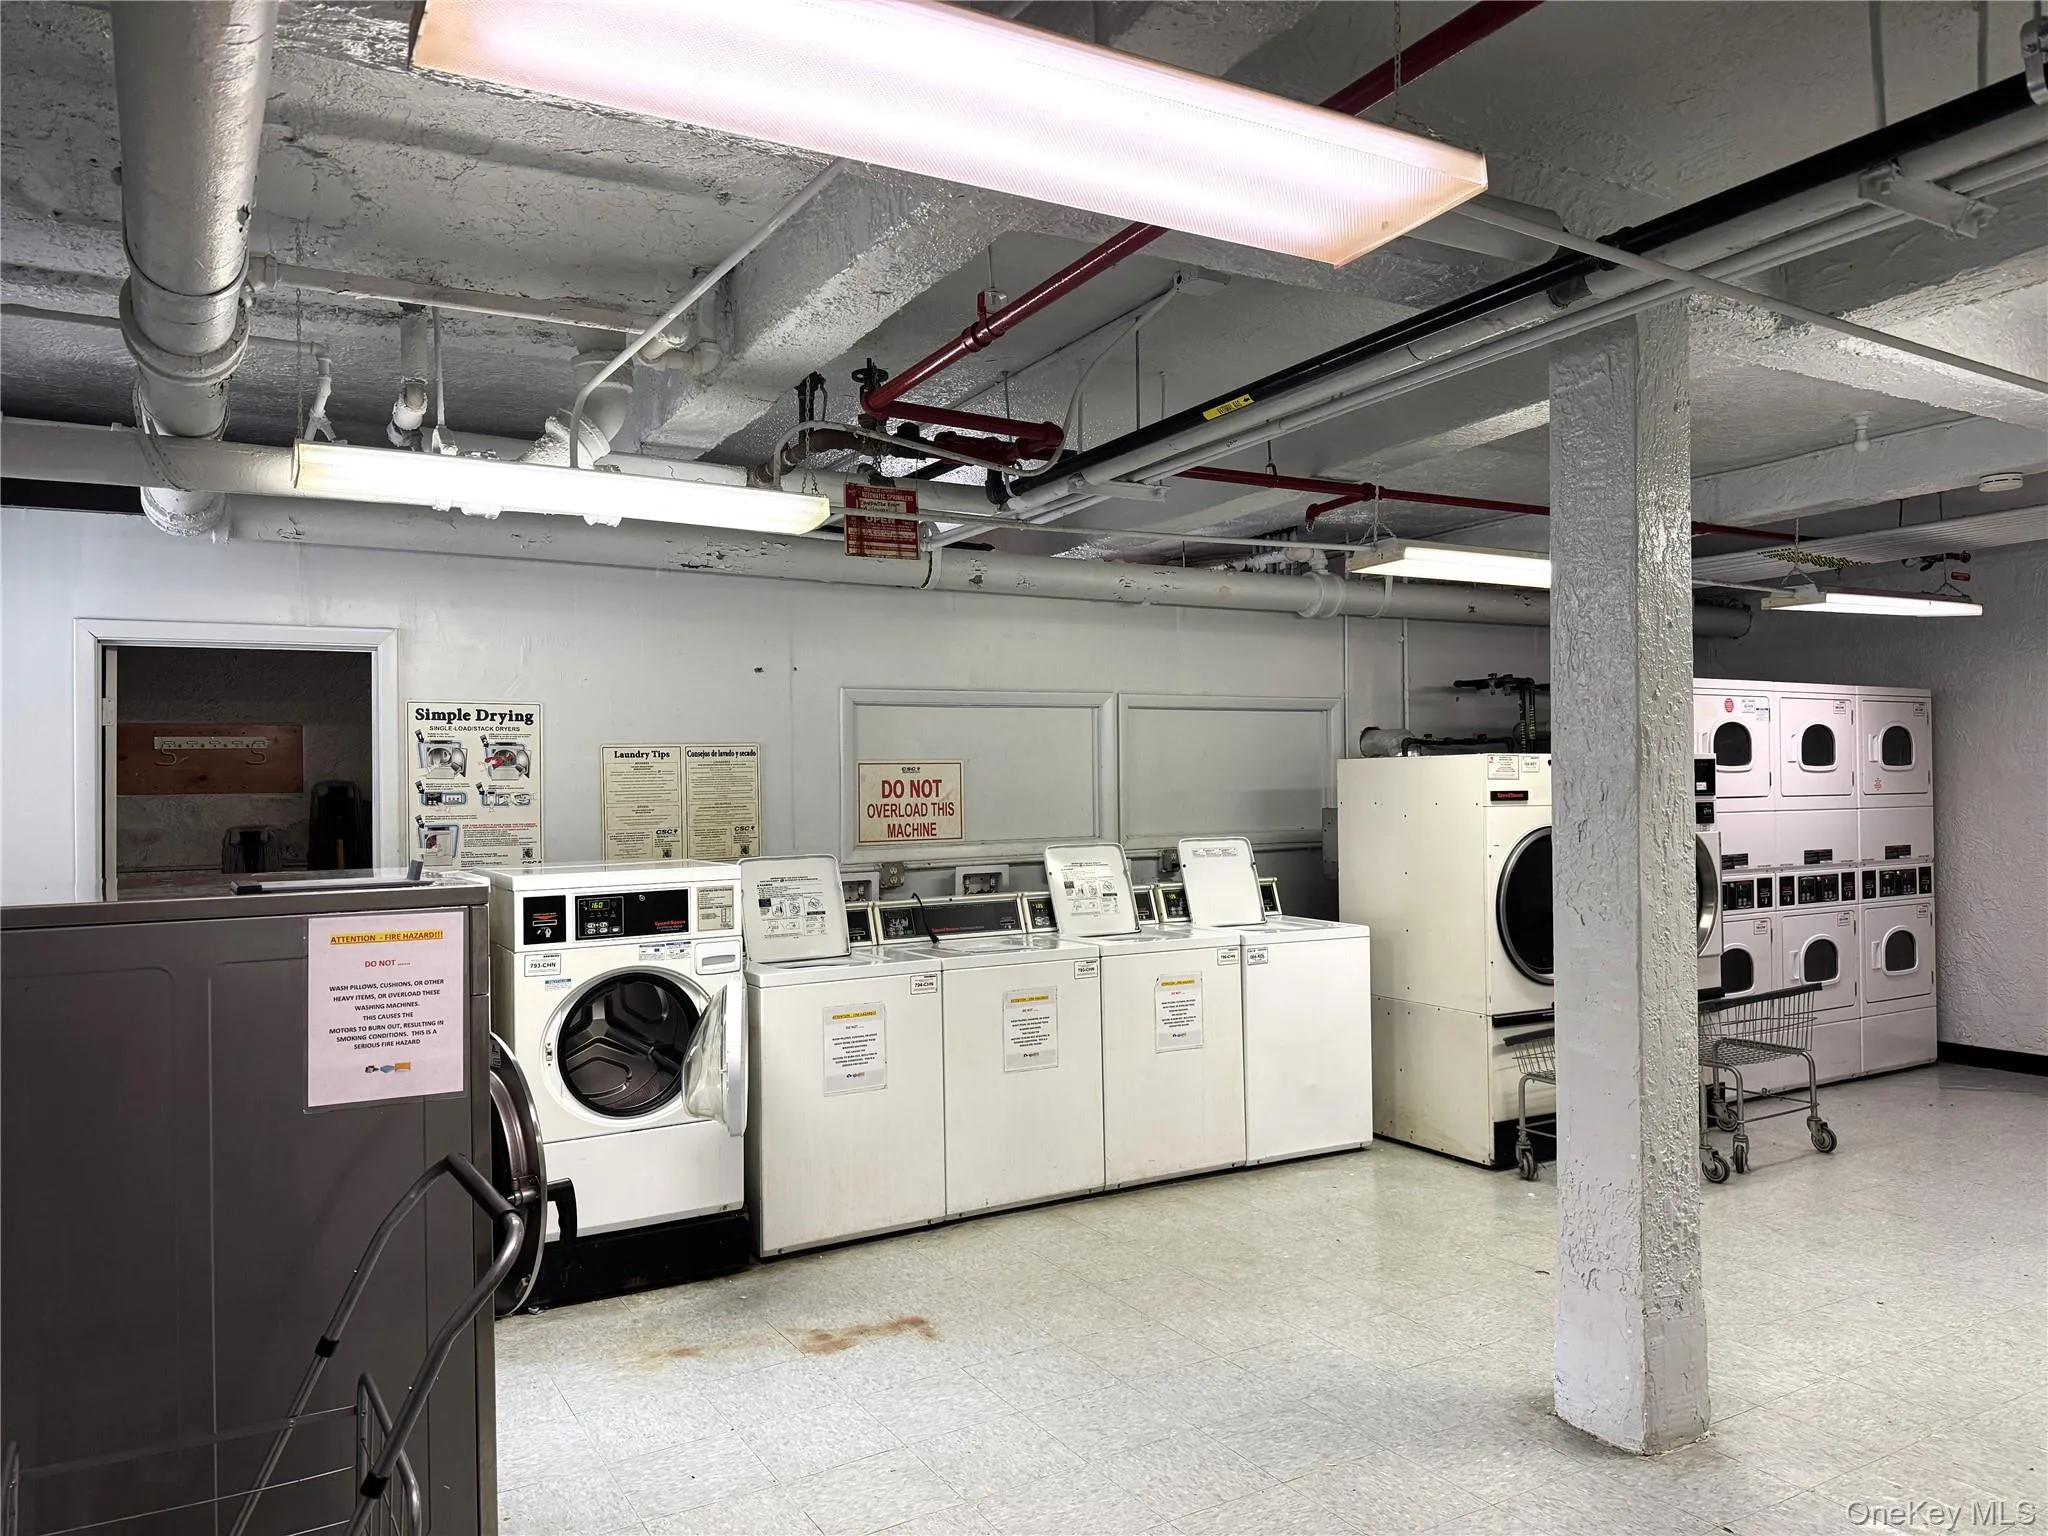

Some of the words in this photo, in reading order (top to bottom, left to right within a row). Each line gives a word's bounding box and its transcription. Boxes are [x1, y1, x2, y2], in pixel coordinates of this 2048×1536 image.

[415, 708, 471, 724] Simple
[476, 709, 534, 725] Drying
[614, 751, 650, 760] Laundry
[652, 751, 669, 759] Tips
[882, 780, 904, 798] DO
[910, 780, 942, 798] NOT
[867, 803, 928, 818] OVERLOAD
[931, 802, 954, 816] THIS
[888, 823, 937, 838] MACHINE
[331, 935, 376, 944] ATTENTION
[403, 931, 443, 940] HAZARD!!!
[380, 981, 413, 989] CUSHIONS,
[368, 1032, 408, 1040] CONDITIONS.
